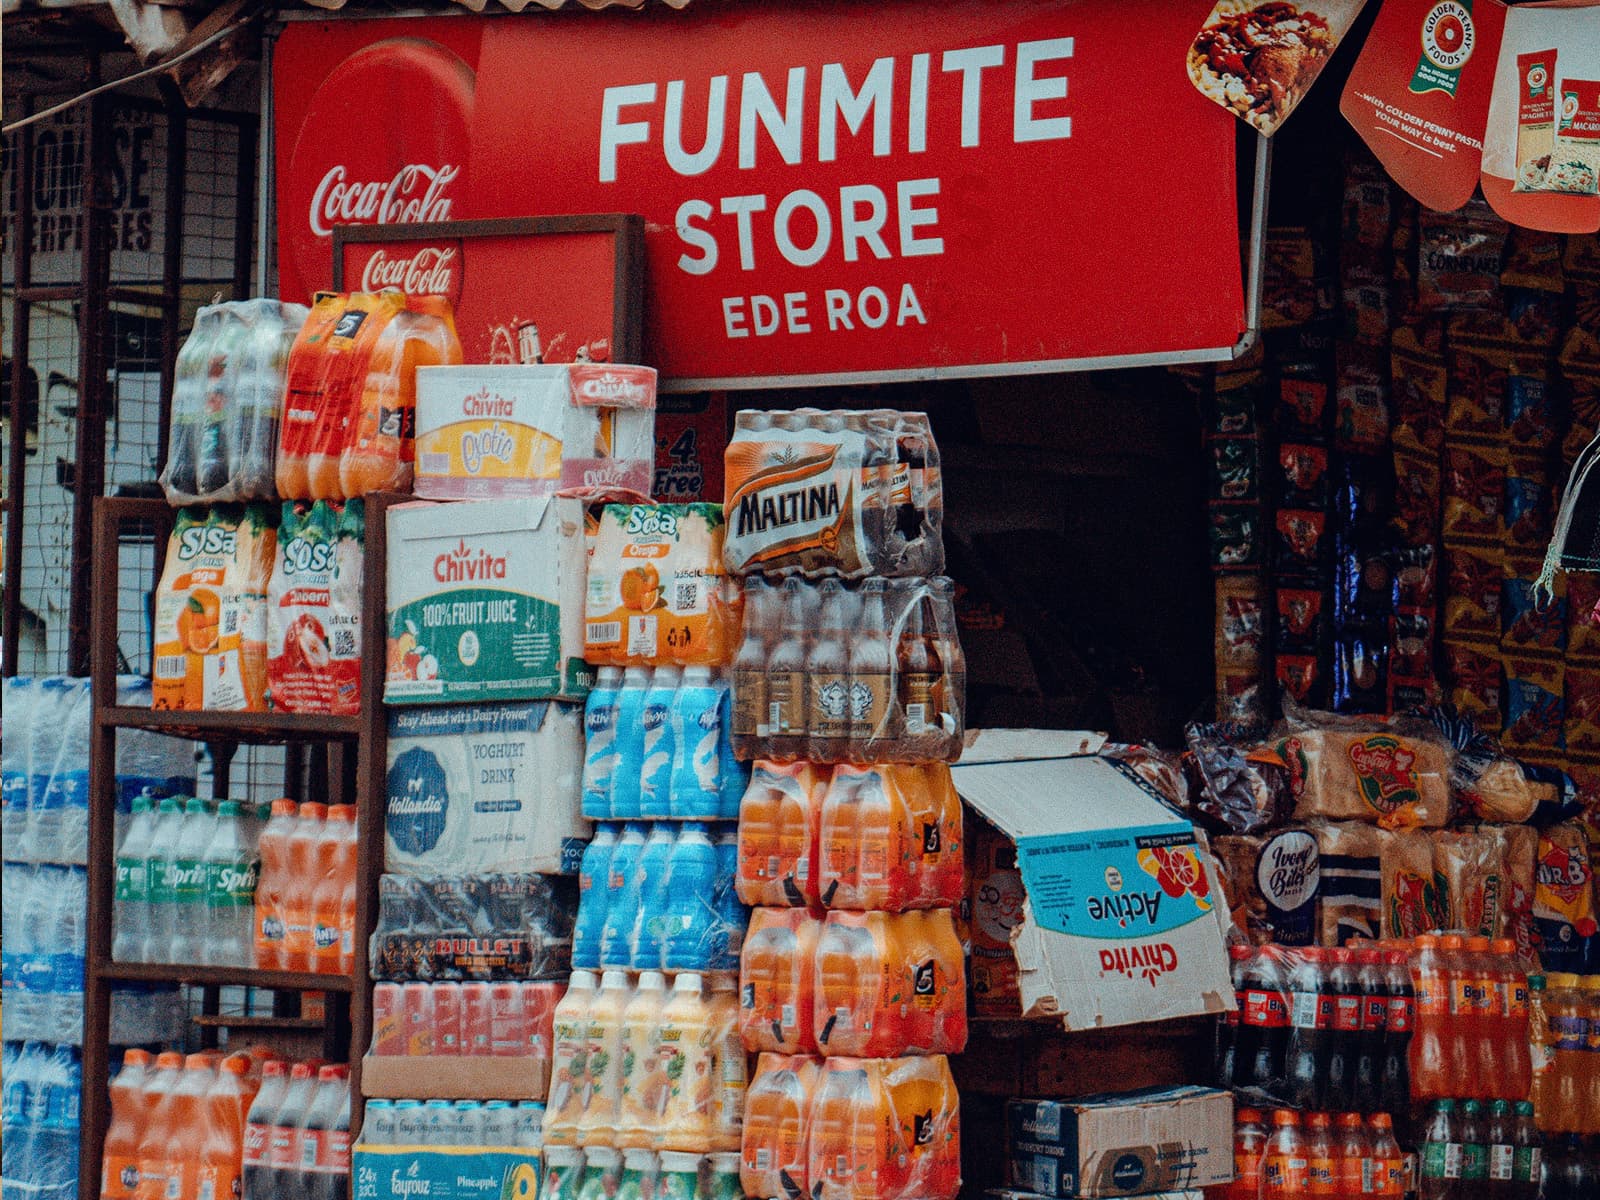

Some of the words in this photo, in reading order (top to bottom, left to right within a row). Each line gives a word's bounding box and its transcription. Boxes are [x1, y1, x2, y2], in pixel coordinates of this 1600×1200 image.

[1425, 3, 1456, 34] GOLDEN
[1457, 9, 1473, 51] PENNY
[1428, 45, 1461, 65] FOODS
[598, 36, 1075, 184] FUNMITE
[1374, 110, 1401, 129] YOUR
[1400, 122, 1424, 139] WAY
[1422, 133, 1432, 143] is
[1385, 104, 1425, 128] GOLDEN
[1424, 119, 1456, 139] PENNY
[309, 163, 460, 237] Coca-Cola
[673, 177, 945, 275] STORE
[360, 247, 457, 295] Coca-Cola
[722, 290, 812, 339] EDE
[825, 282, 928, 332] ROA
[462, 388, 514, 417] Chivita
[653, 469, 703, 494] Free
[735, 483, 841, 539] MALTINA
[433, 541, 506, 583] Chivita
[422, 602, 452, 628] 100%
[451, 600, 485, 626] FRUIT
[485, 598, 518, 624] JUICE
[473, 742, 526, 760] YOGHURT
[480, 767, 516, 784] DRINK
[387, 795, 444, 815] Hollandia
[1272, 845, 1313, 868] Ivory
[1270, 866, 1305, 898] Bites
[1088, 889, 1162, 928] Active
[435, 937, 523, 956] BULLET
[1098, 942, 1178, 981] Chivita
[391, 1168, 431, 1200] fayrouz
